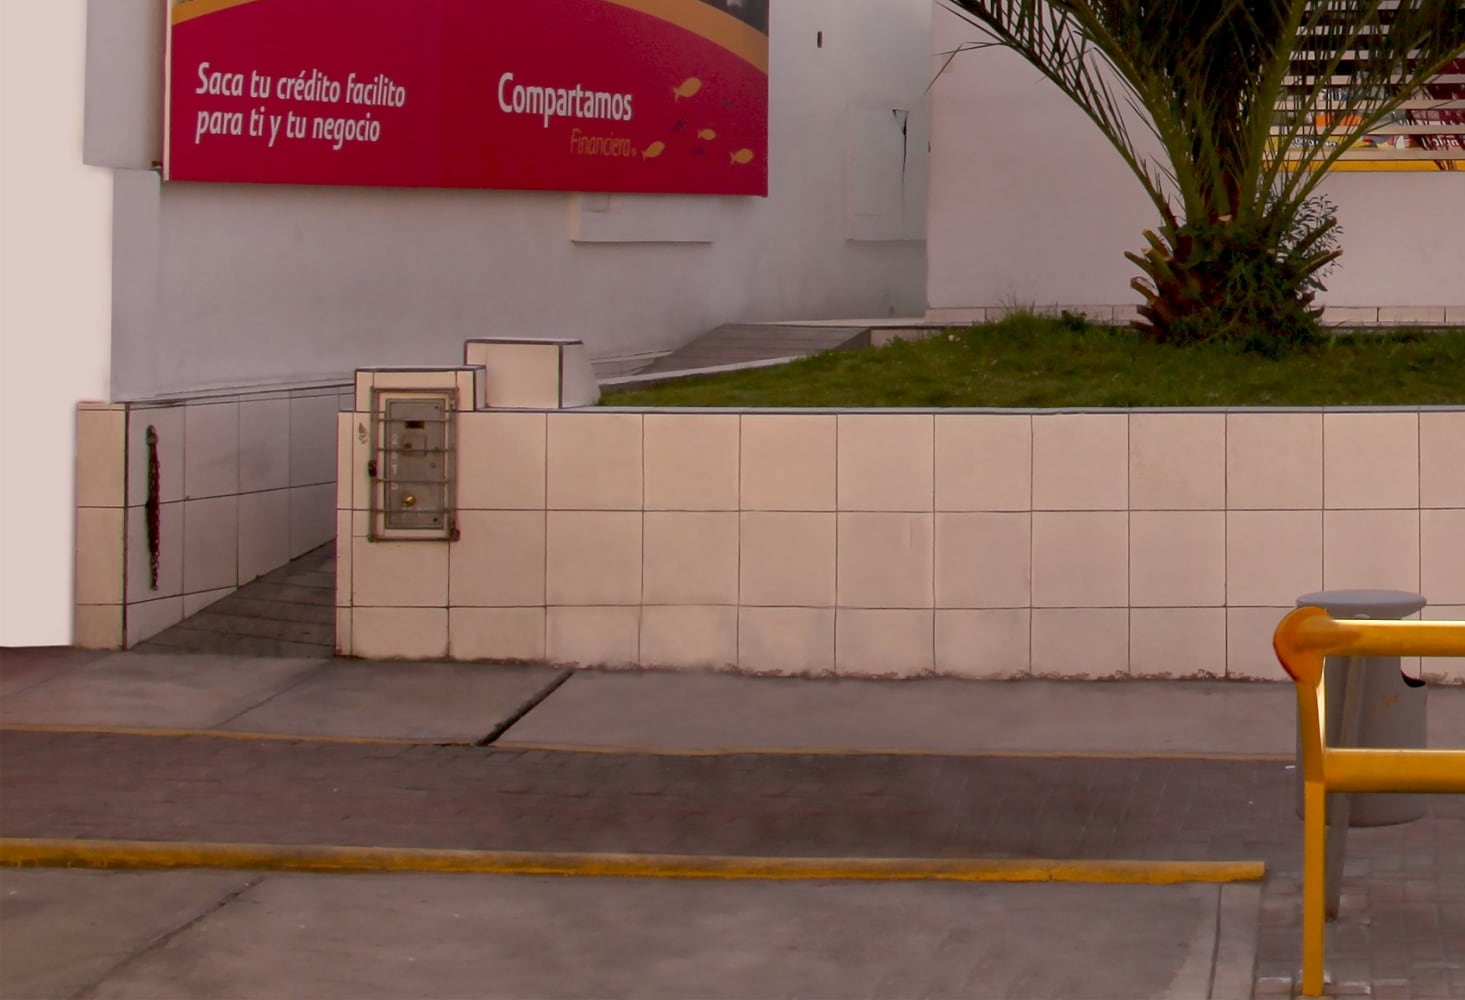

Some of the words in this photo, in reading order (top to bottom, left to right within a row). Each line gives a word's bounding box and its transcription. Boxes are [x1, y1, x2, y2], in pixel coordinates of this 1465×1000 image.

[195, 61, 244, 97] Saca
[250, 69, 271, 99] tu
[276, 68, 341, 103] crédito
[346, 72, 406, 107] facilito
[497, 72, 633, 128] Compartamos
[195, 109, 243, 145] para
[249, 106, 266, 137] ti
[268, 114, 282, 148] y
[286, 111, 307, 139] tu
[312, 113, 381, 151] negocio
